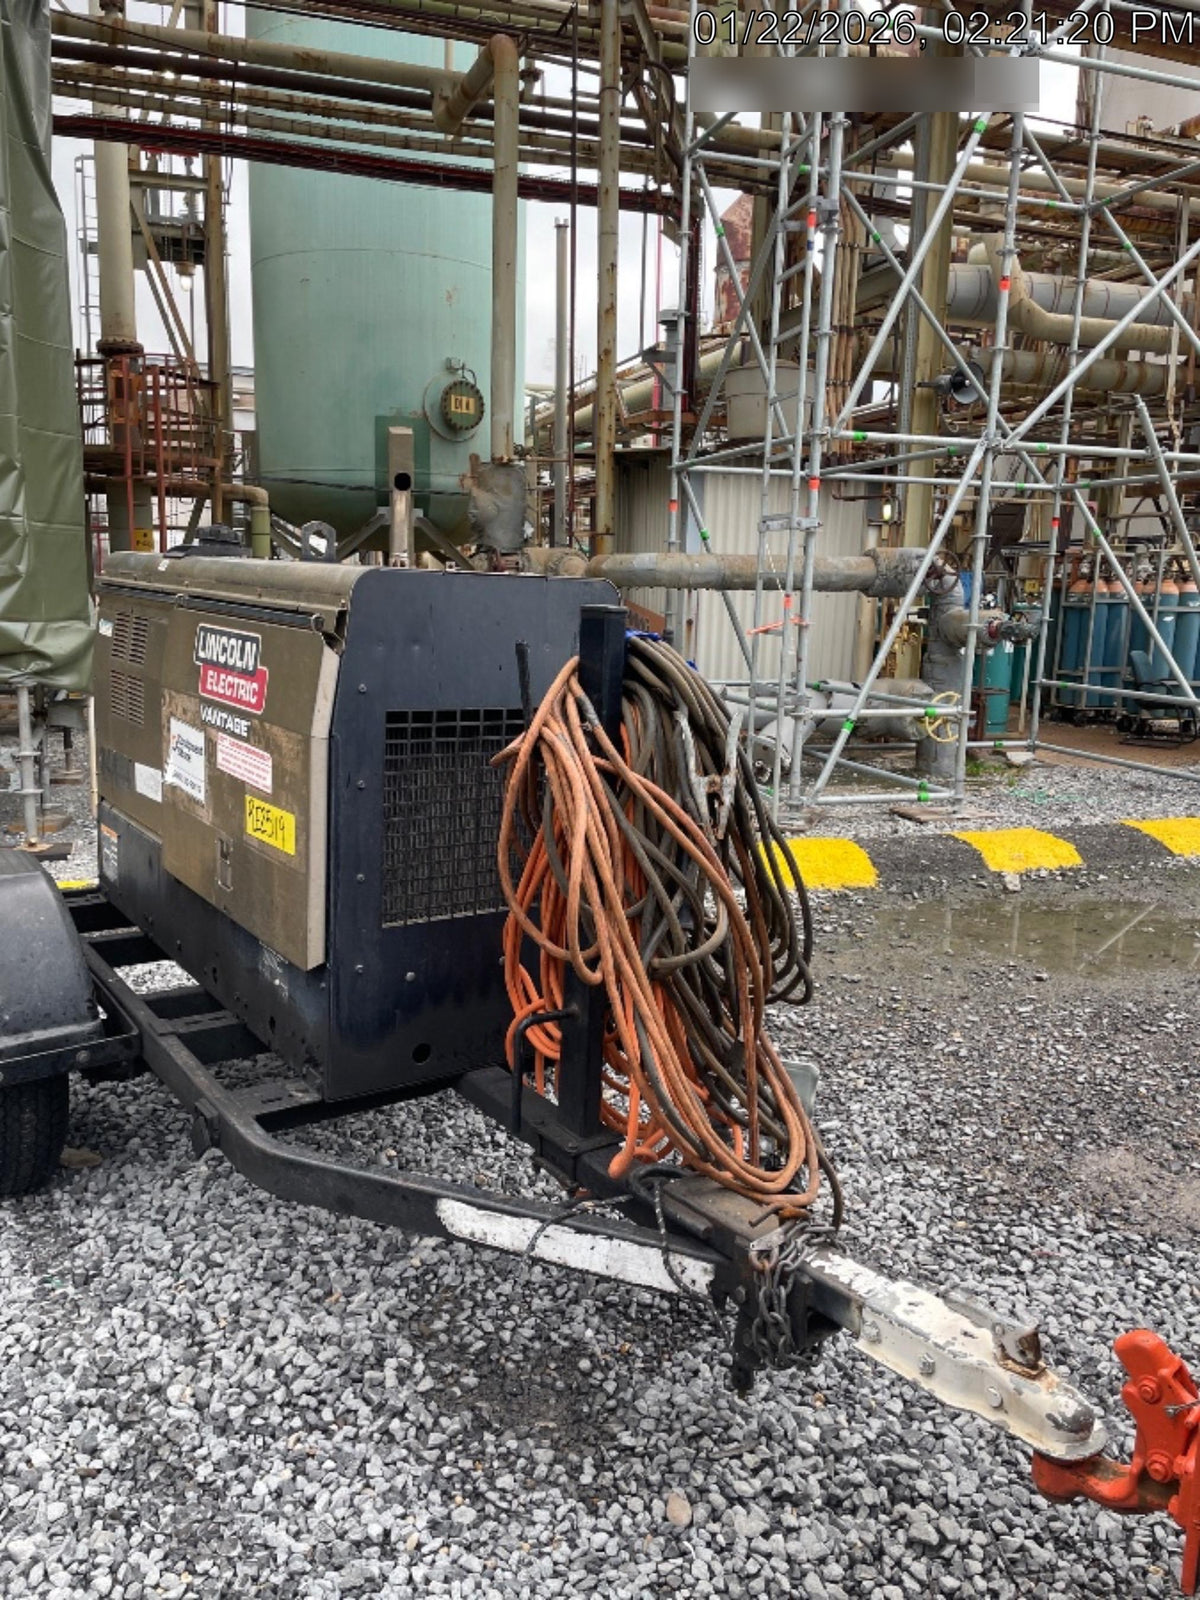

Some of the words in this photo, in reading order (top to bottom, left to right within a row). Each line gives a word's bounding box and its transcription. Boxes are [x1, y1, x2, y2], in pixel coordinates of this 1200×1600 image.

[198, 630, 257, 672] LINCOLN
[205, 669, 260, 705] ELECTRIC
[200, 702, 251, 738] VANTAGE
